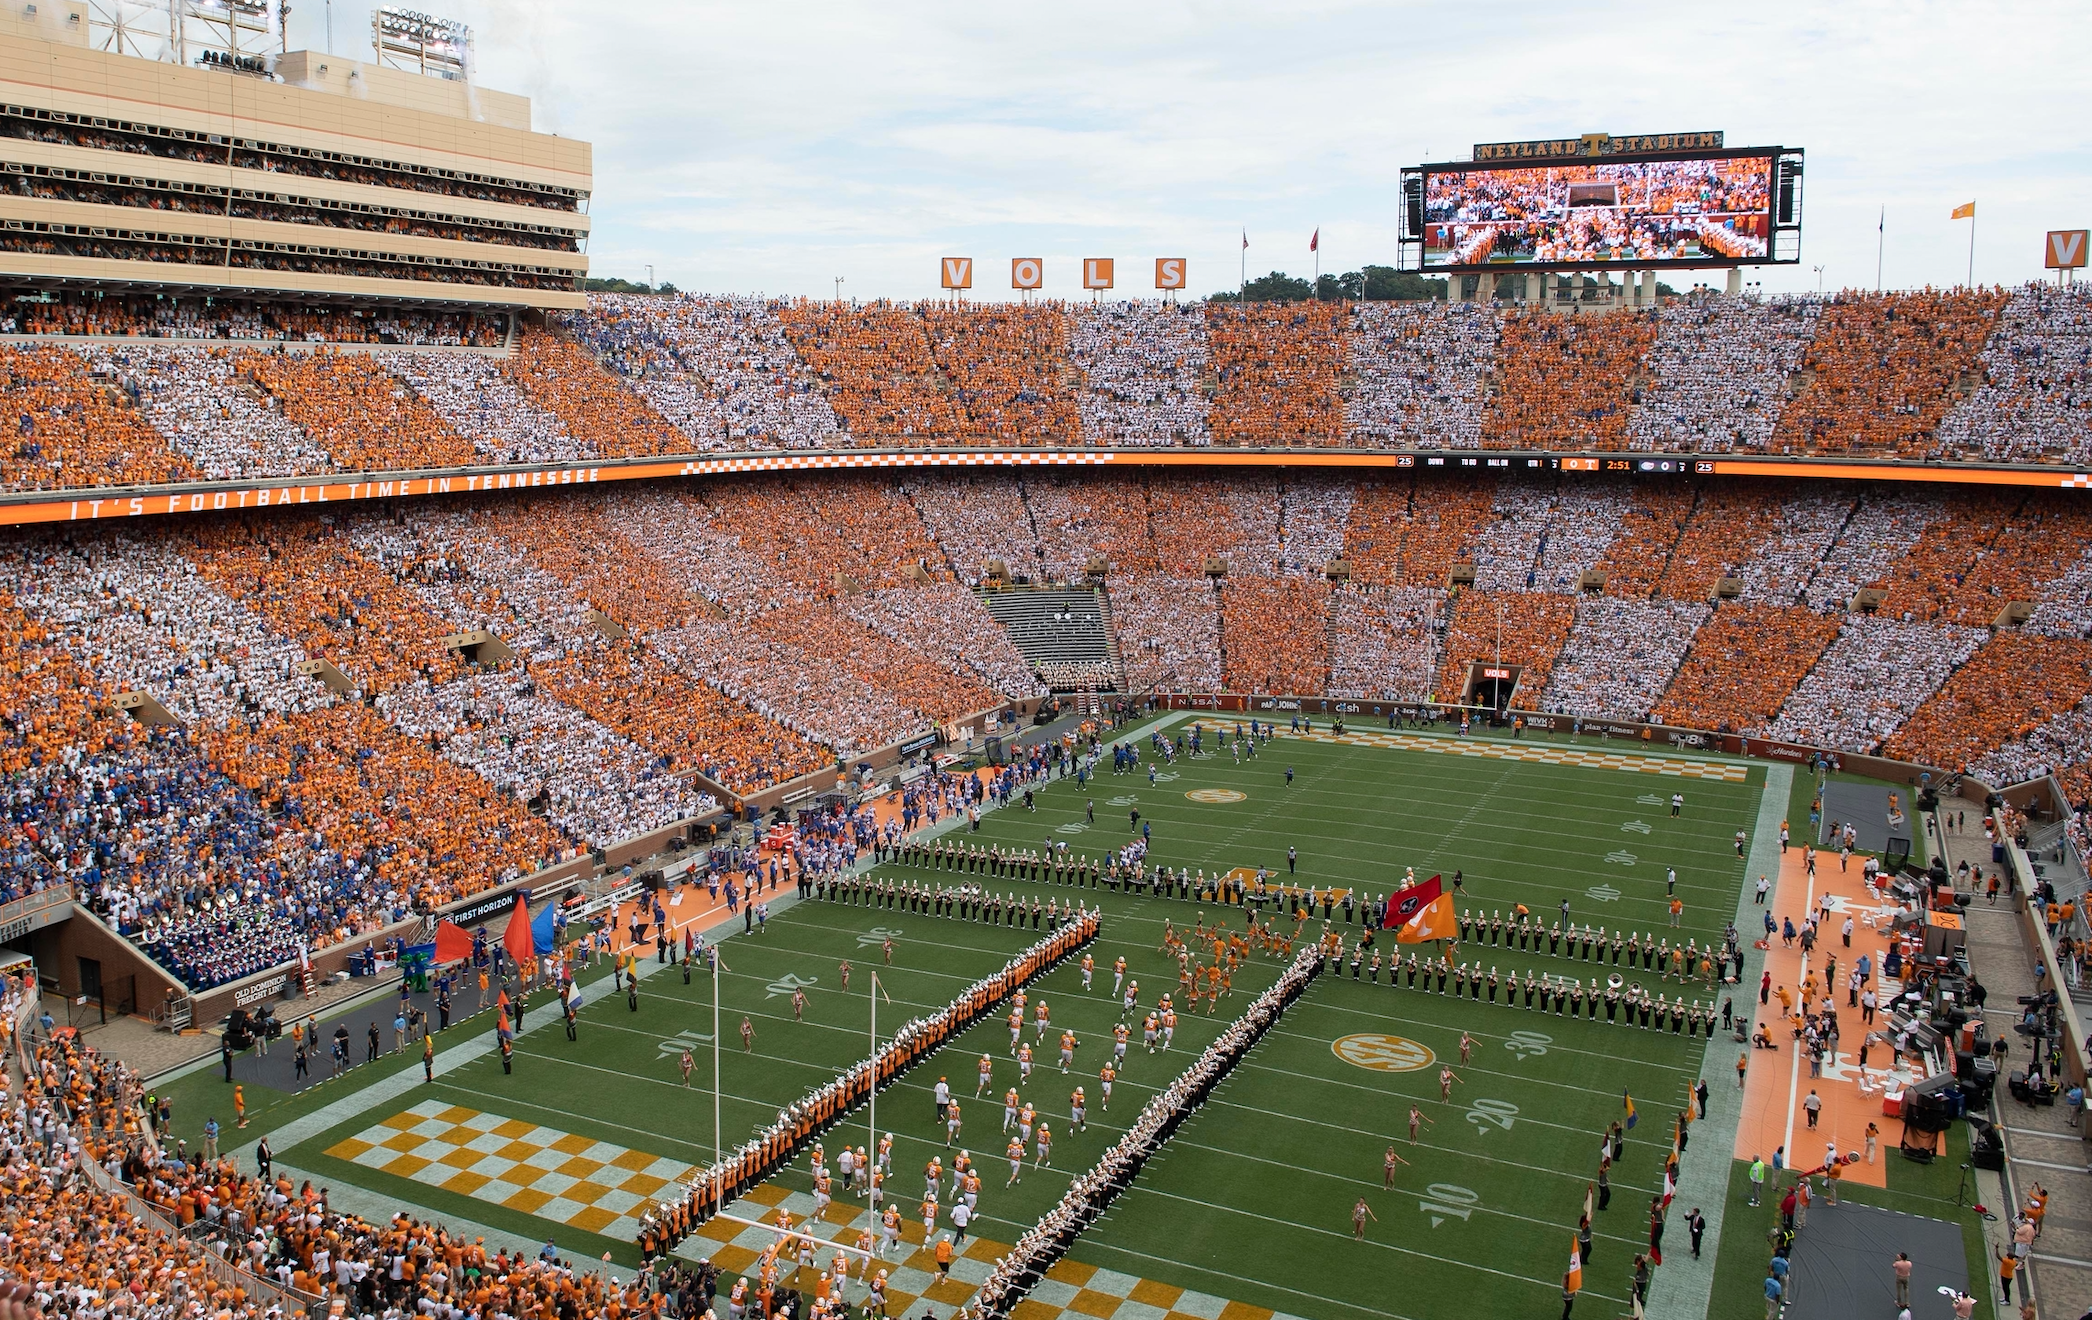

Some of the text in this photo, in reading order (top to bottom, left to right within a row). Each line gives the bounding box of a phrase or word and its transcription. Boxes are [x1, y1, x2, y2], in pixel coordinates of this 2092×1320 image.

[1480, 133, 1715, 159] NEYLAND T STADIUM
[2051, 233, 2083, 264] V
[1398, 457, 1412, 465] 25
[1569, 460, 1595, 469] 0 T
[1607, 460, 1630, 470] 2:51
[1661, 462, 1669, 471] 0
[1697, 464, 1712, 472] 25
[70, 469, 598, 520] IT'S FOOTBALL TIME IN TENNESSEE
[1609, 725, 1635, 735] fitness
[454, 895, 513, 924] FIRST HORIZON
[0, 916, 33, 935] FAMILY
[234, 974, 287, 999] OLD DOMINION
[765, 973, 818, 994] 20
[236, 990, 268, 1008] FREIGHT
[1504, 1030, 1553, 1055] 30
[1465, 1098, 1520, 1131] 20
[1419, 1182, 1479, 1222] 10
[836, 1262, 847, 1272] 21
